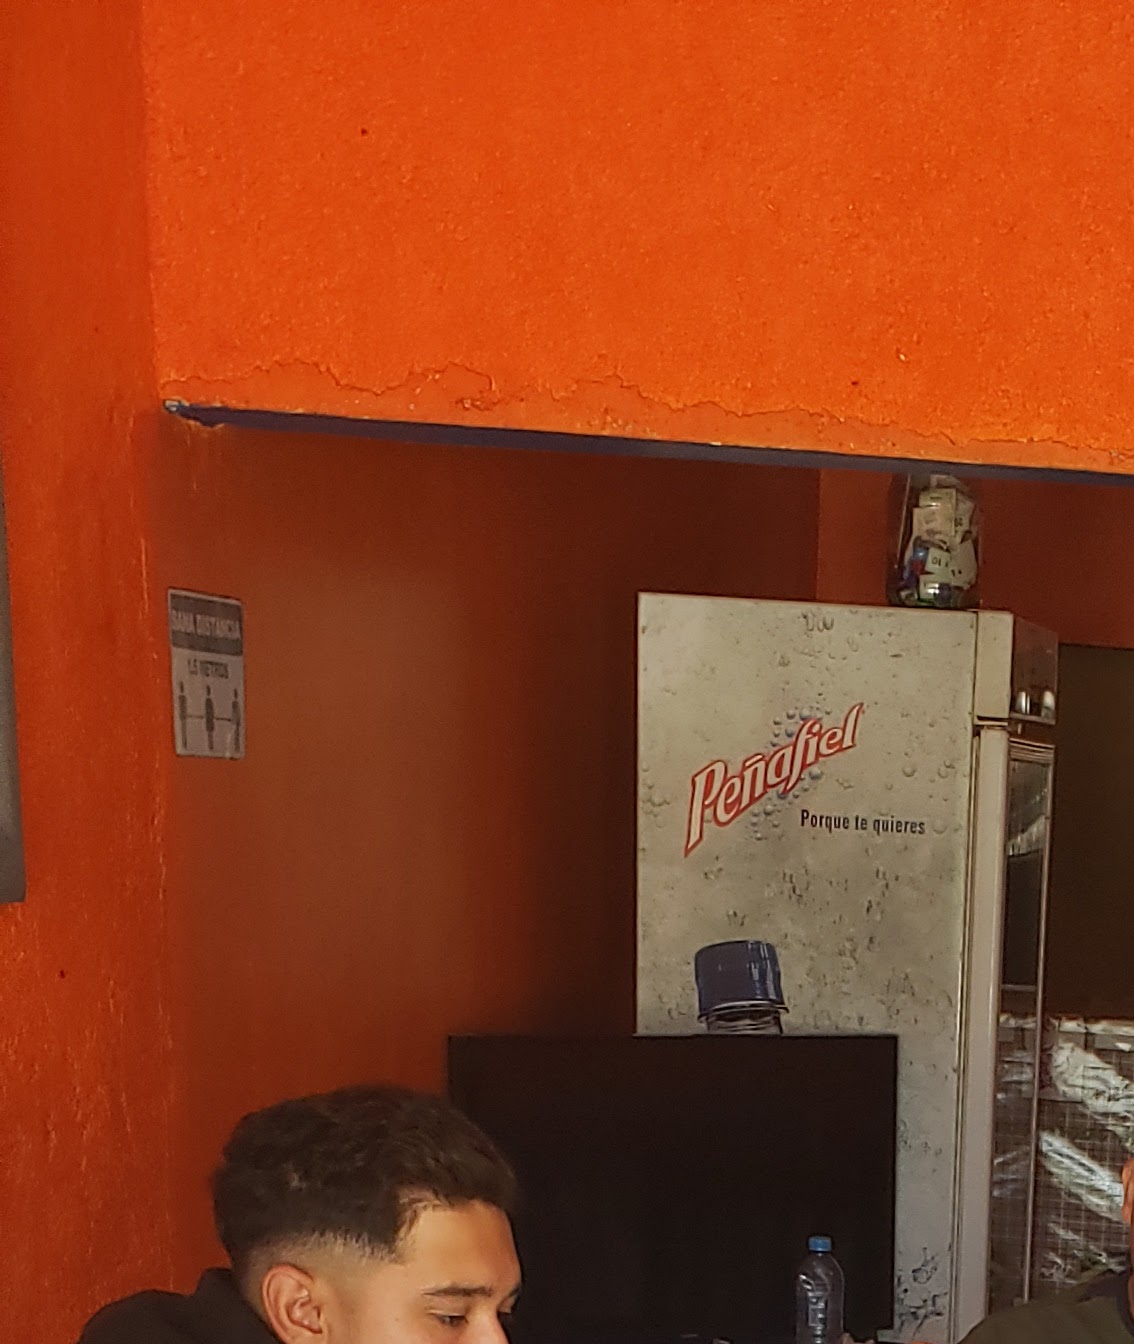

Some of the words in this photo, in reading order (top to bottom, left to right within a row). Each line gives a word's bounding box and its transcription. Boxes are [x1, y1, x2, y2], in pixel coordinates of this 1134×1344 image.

[684, 702, 865, 859] Peñafiel
[800, 809, 850, 834] Porque
[854, 814, 868, 831] te
[872, 815, 927, 836] quieres
